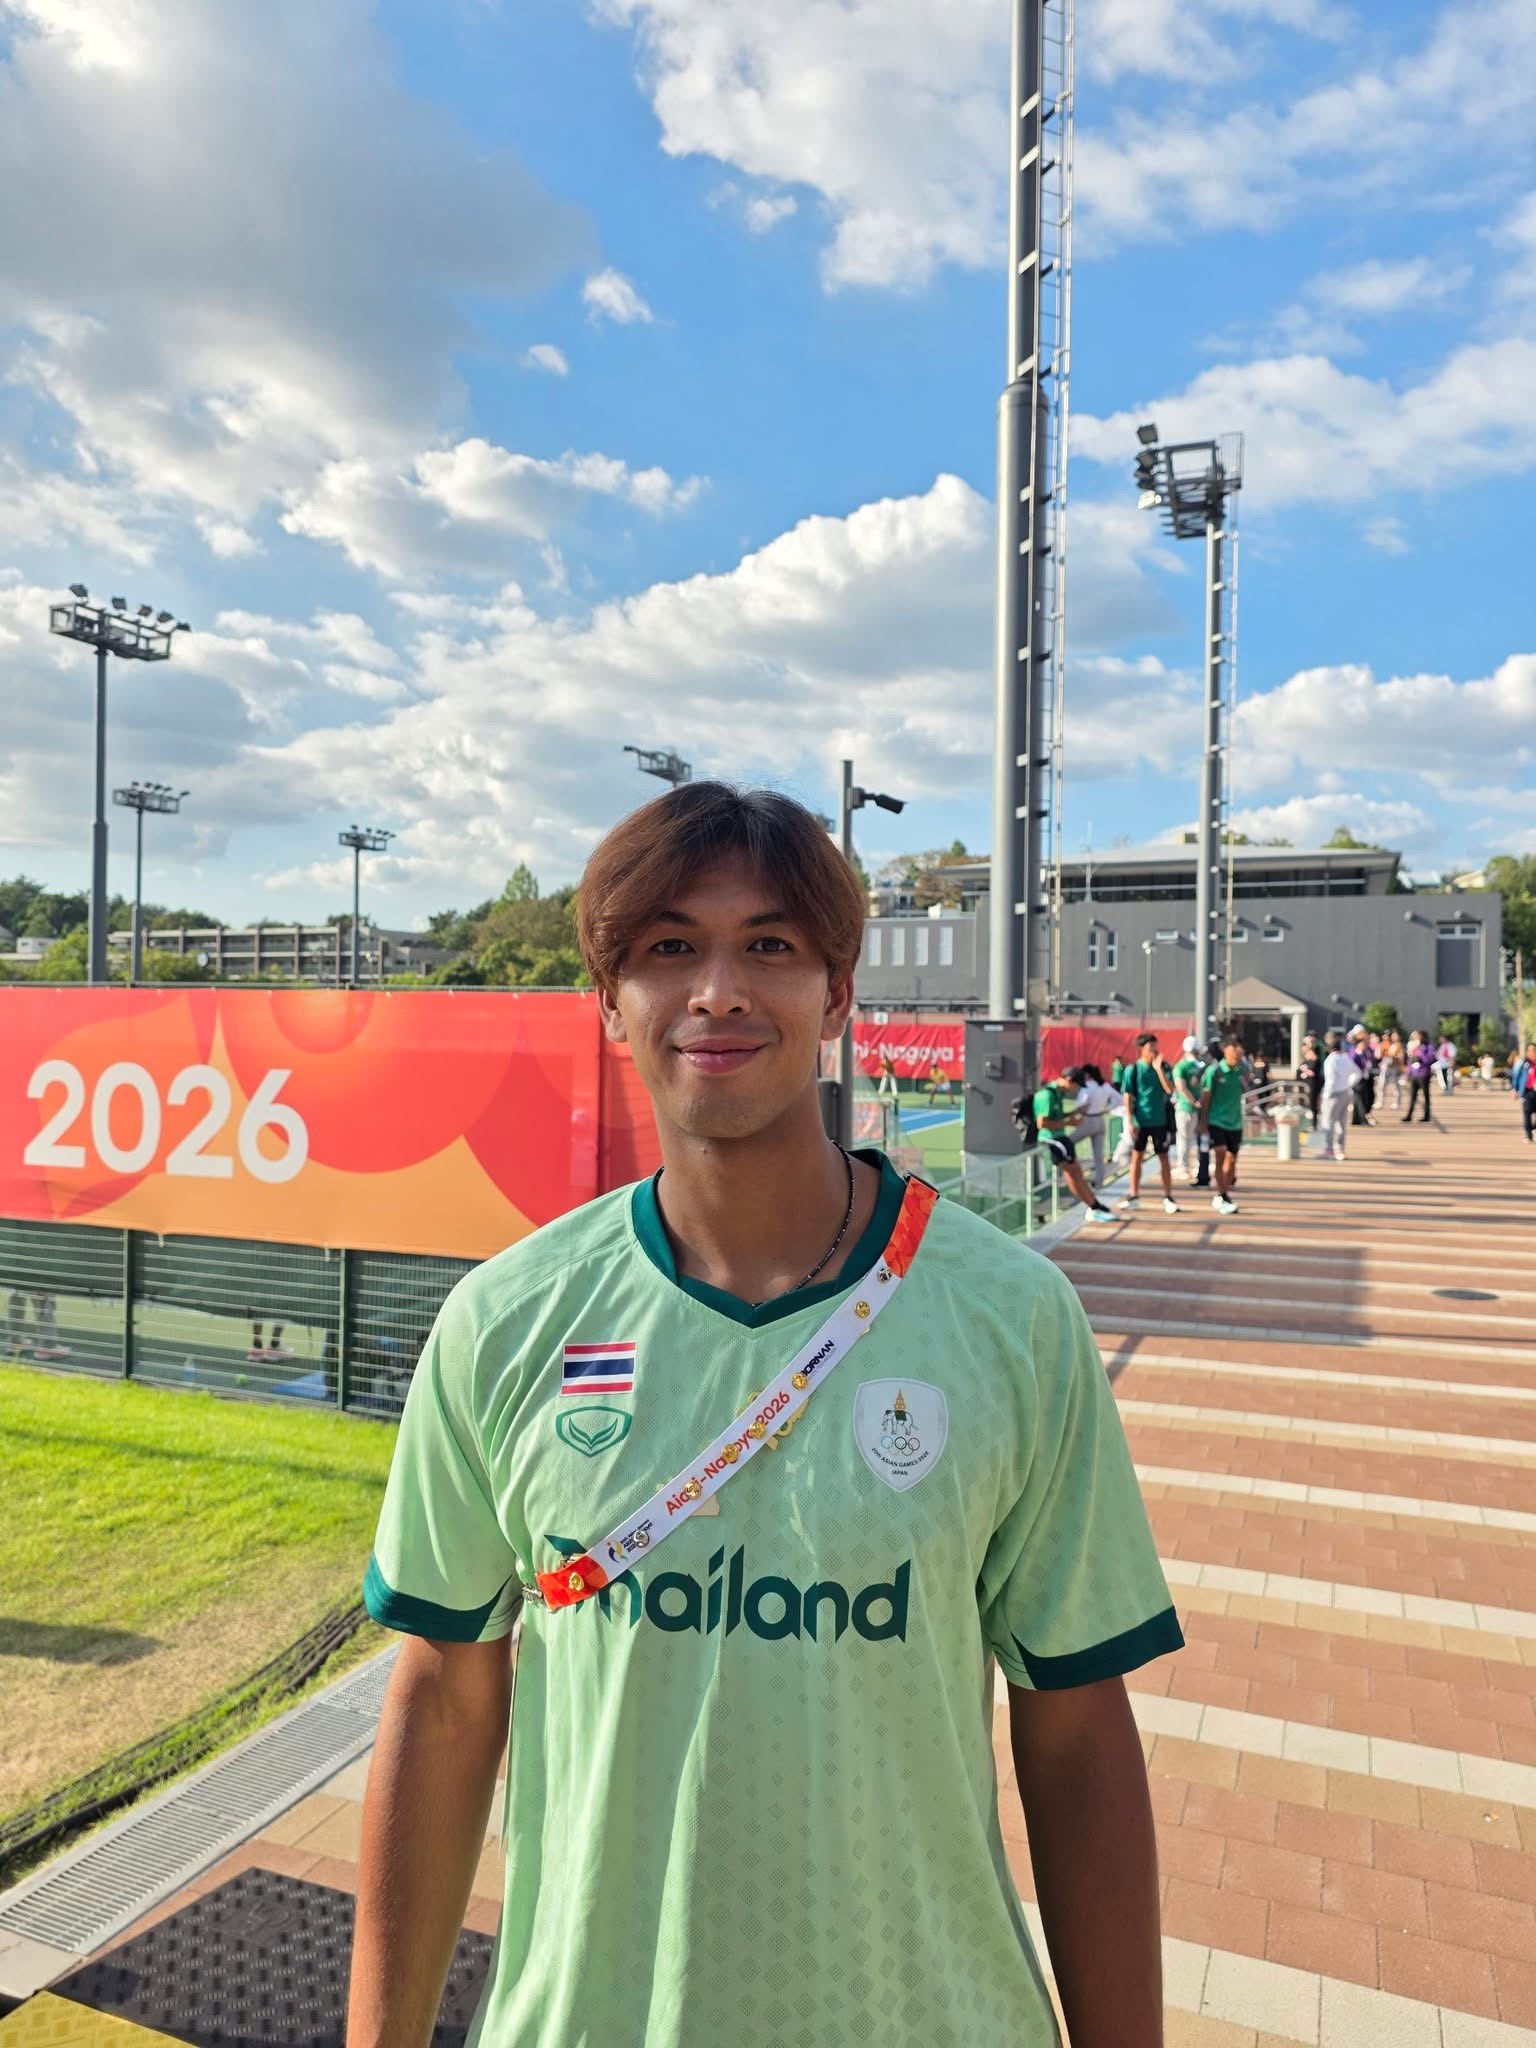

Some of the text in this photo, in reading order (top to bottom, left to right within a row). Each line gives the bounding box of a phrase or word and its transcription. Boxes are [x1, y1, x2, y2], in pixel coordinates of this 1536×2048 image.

[23, 1059, 309, 1185] 2026
[755, 1391, 790, 1425] 2026
[881, 1456, 898, 1467] ASIAN
[899, 1459, 918, 1468] GAMES
